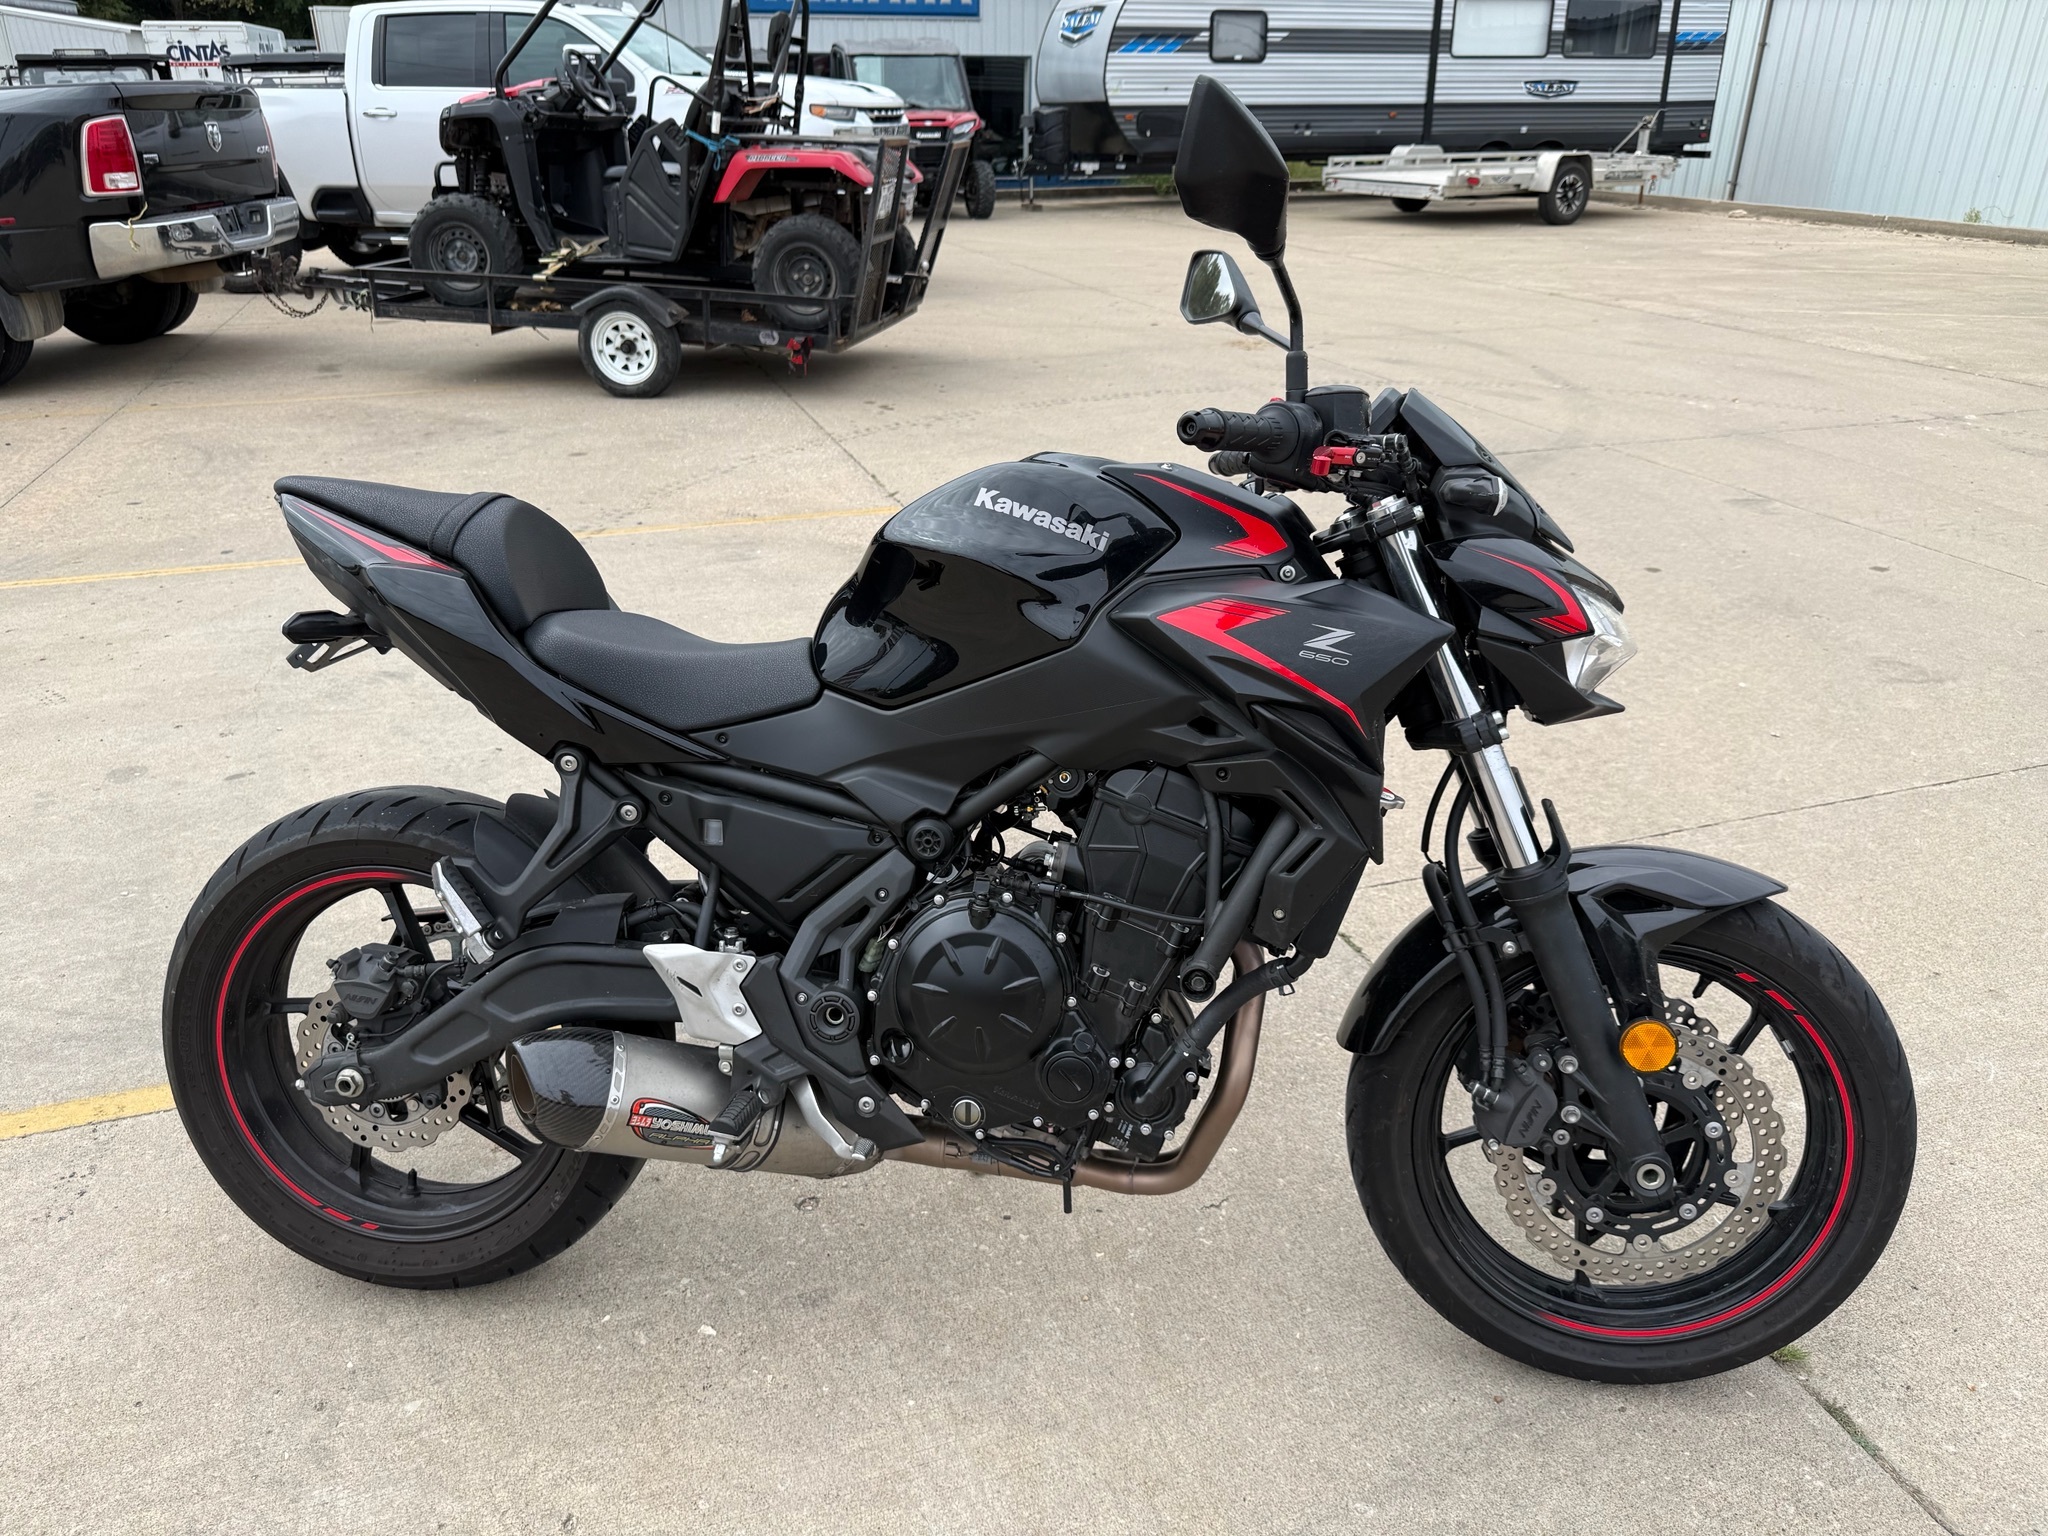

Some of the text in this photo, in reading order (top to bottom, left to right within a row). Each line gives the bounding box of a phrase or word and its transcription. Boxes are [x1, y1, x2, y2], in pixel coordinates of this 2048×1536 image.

[1060, 12, 1101, 28] SALEM
[166, 39, 231, 61] CINTAS
[1525, 83, 1575, 92] SALEM
[974, 487, 1110, 552] Kawasaki
[1303, 623, 1356, 656] Z
[1298, 650, 1350, 666] 650
[651, 1117, 711, 1135] YOSHIMU
